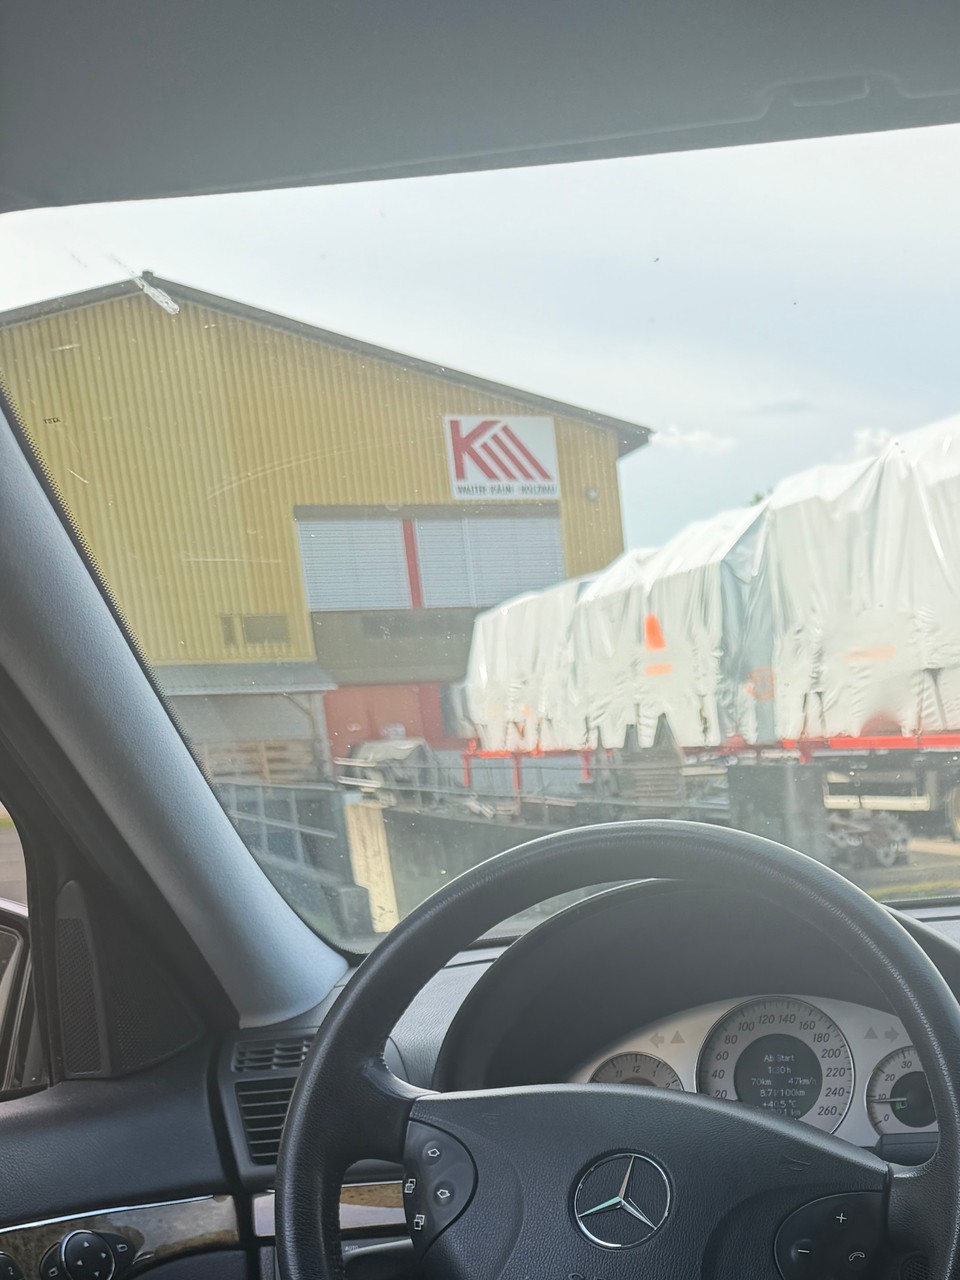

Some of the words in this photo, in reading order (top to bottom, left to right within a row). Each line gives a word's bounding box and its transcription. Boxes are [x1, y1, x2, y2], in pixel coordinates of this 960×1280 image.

[759, 1015, 775, 1024] 120
[779, 1014, 796, 1023] 140
[738, 1022, 755, 1031] 100
[800, 1021, 815, 1030] 160
[725, 1035, 737, 1044] 80
[813, 1033, 830, 1042] 180
[716, 1051, 728, 1060] 60
[821, 1049, 841, 1058] 200
[712, 1070, 725, 1079] 40
[826, 1068, 845, 1077] 220
[716, 1090, 727, 1099] 20
[825, 1088, 845, 1096] 240
[818, 1106, 837, 1116] 260
